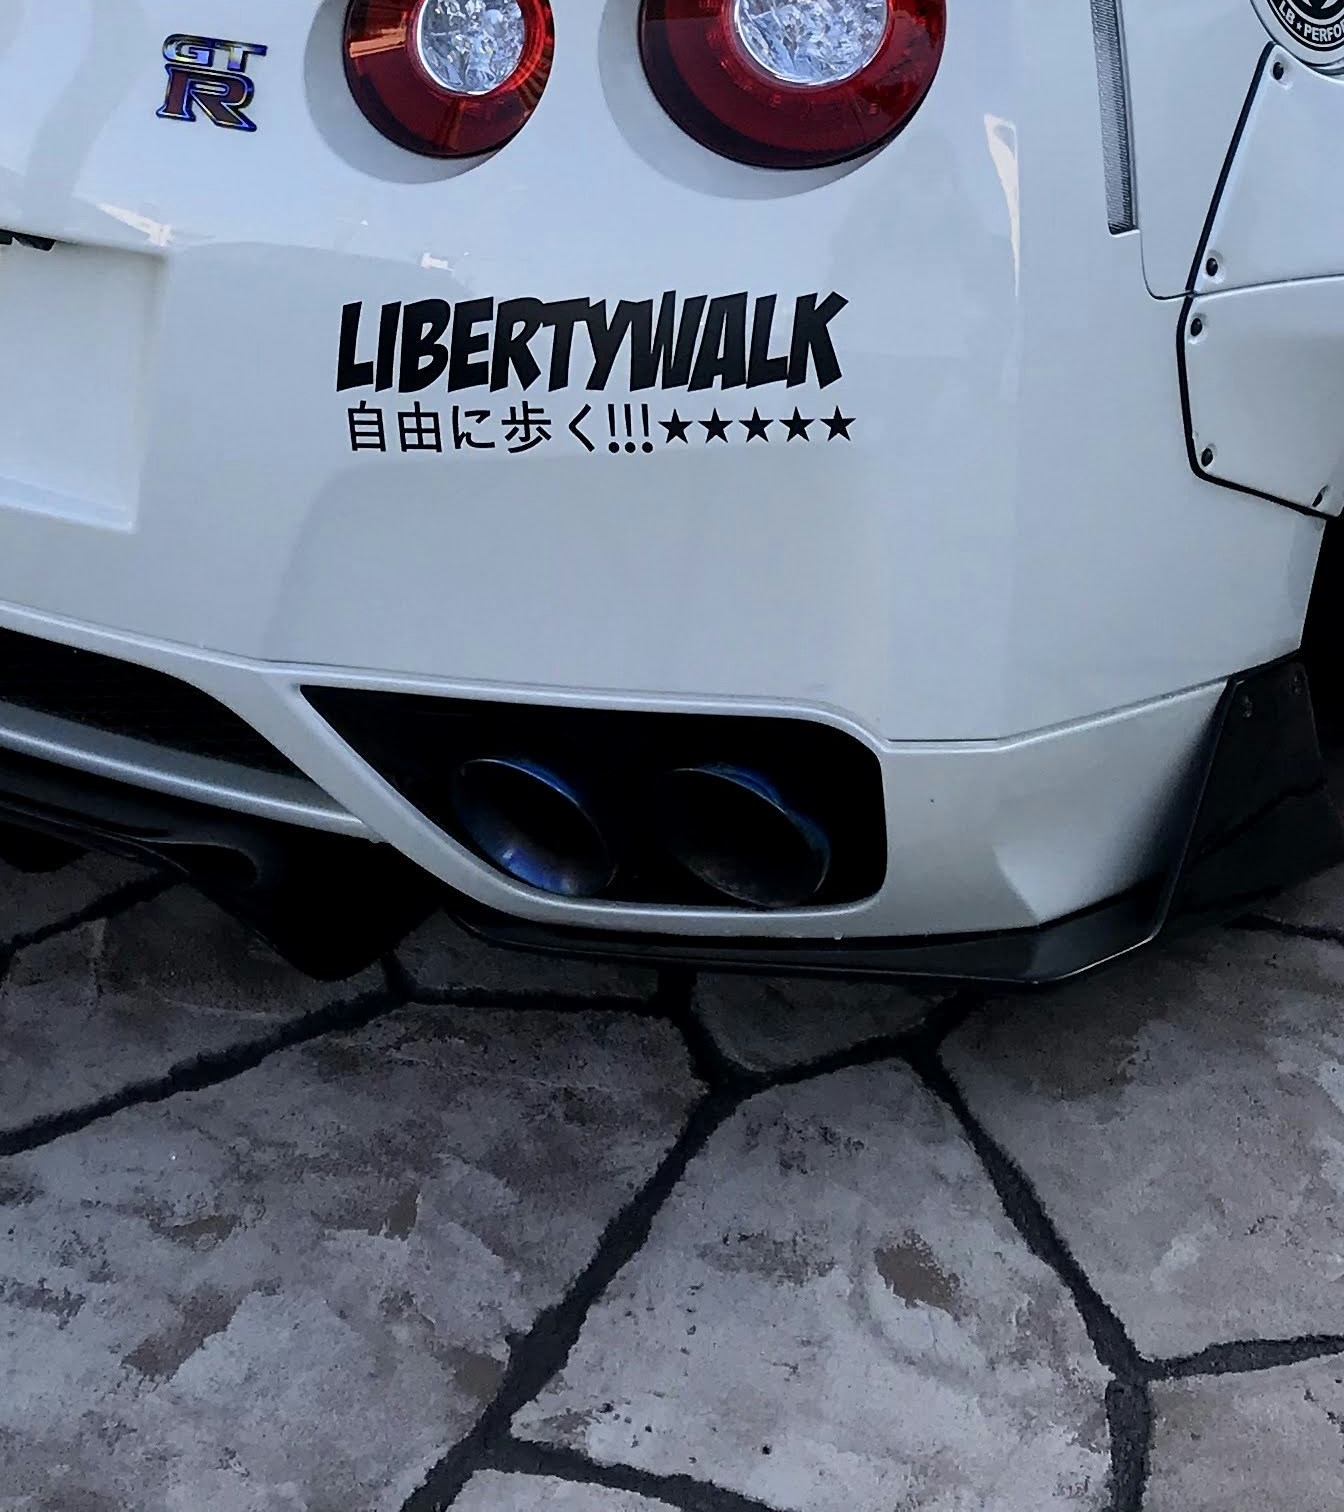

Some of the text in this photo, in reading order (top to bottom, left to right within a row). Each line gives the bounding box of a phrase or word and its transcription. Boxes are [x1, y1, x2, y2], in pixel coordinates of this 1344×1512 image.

[1278, 0, 1295, 26] LB
[162, 34, 268, 72] GT
[156, 63, 258, 132] R
